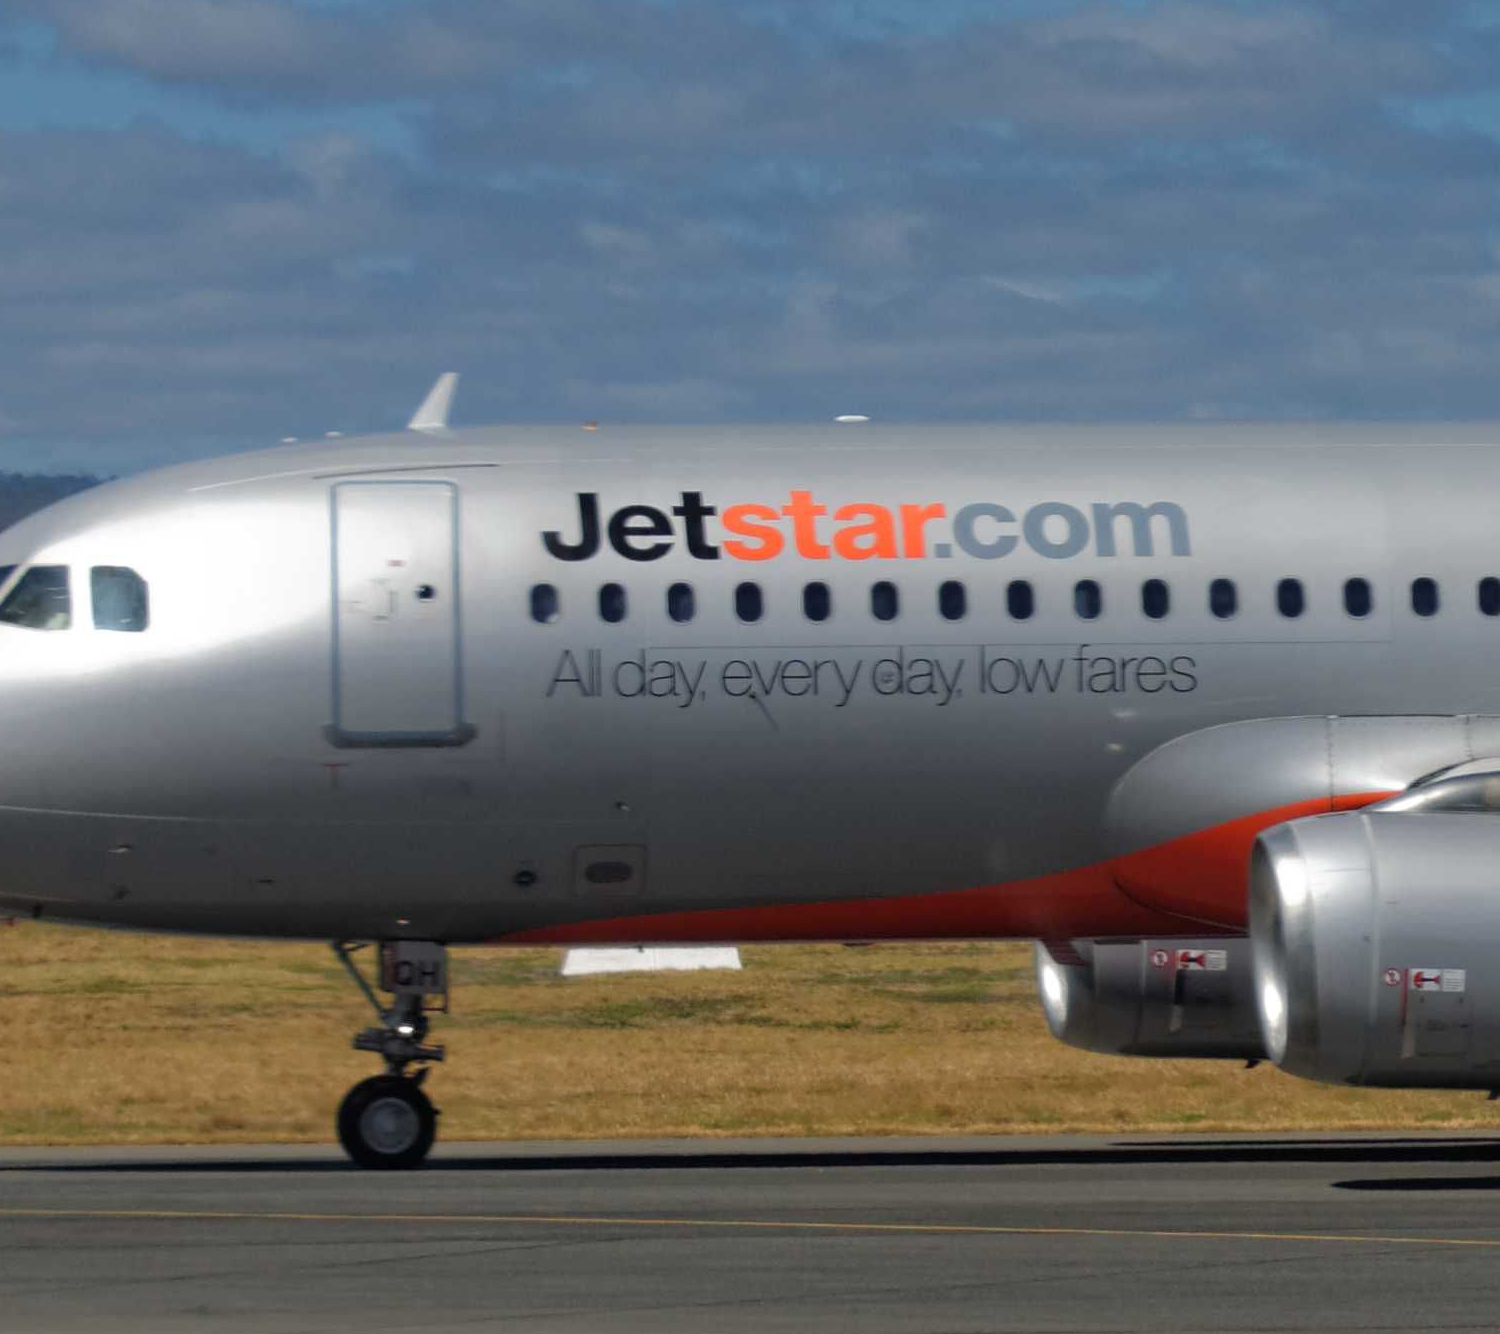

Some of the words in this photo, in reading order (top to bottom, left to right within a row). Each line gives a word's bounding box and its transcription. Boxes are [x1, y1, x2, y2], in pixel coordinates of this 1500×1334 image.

[540, 490, 1193, 562] Jetstar.com
[547, 648, 601, 697] All
[615, 648, 707, 708] day,
[722, 659, 862, 708] every
[980, 645, 1064, 694] low
[1071, 643, 1197, 694] fares
